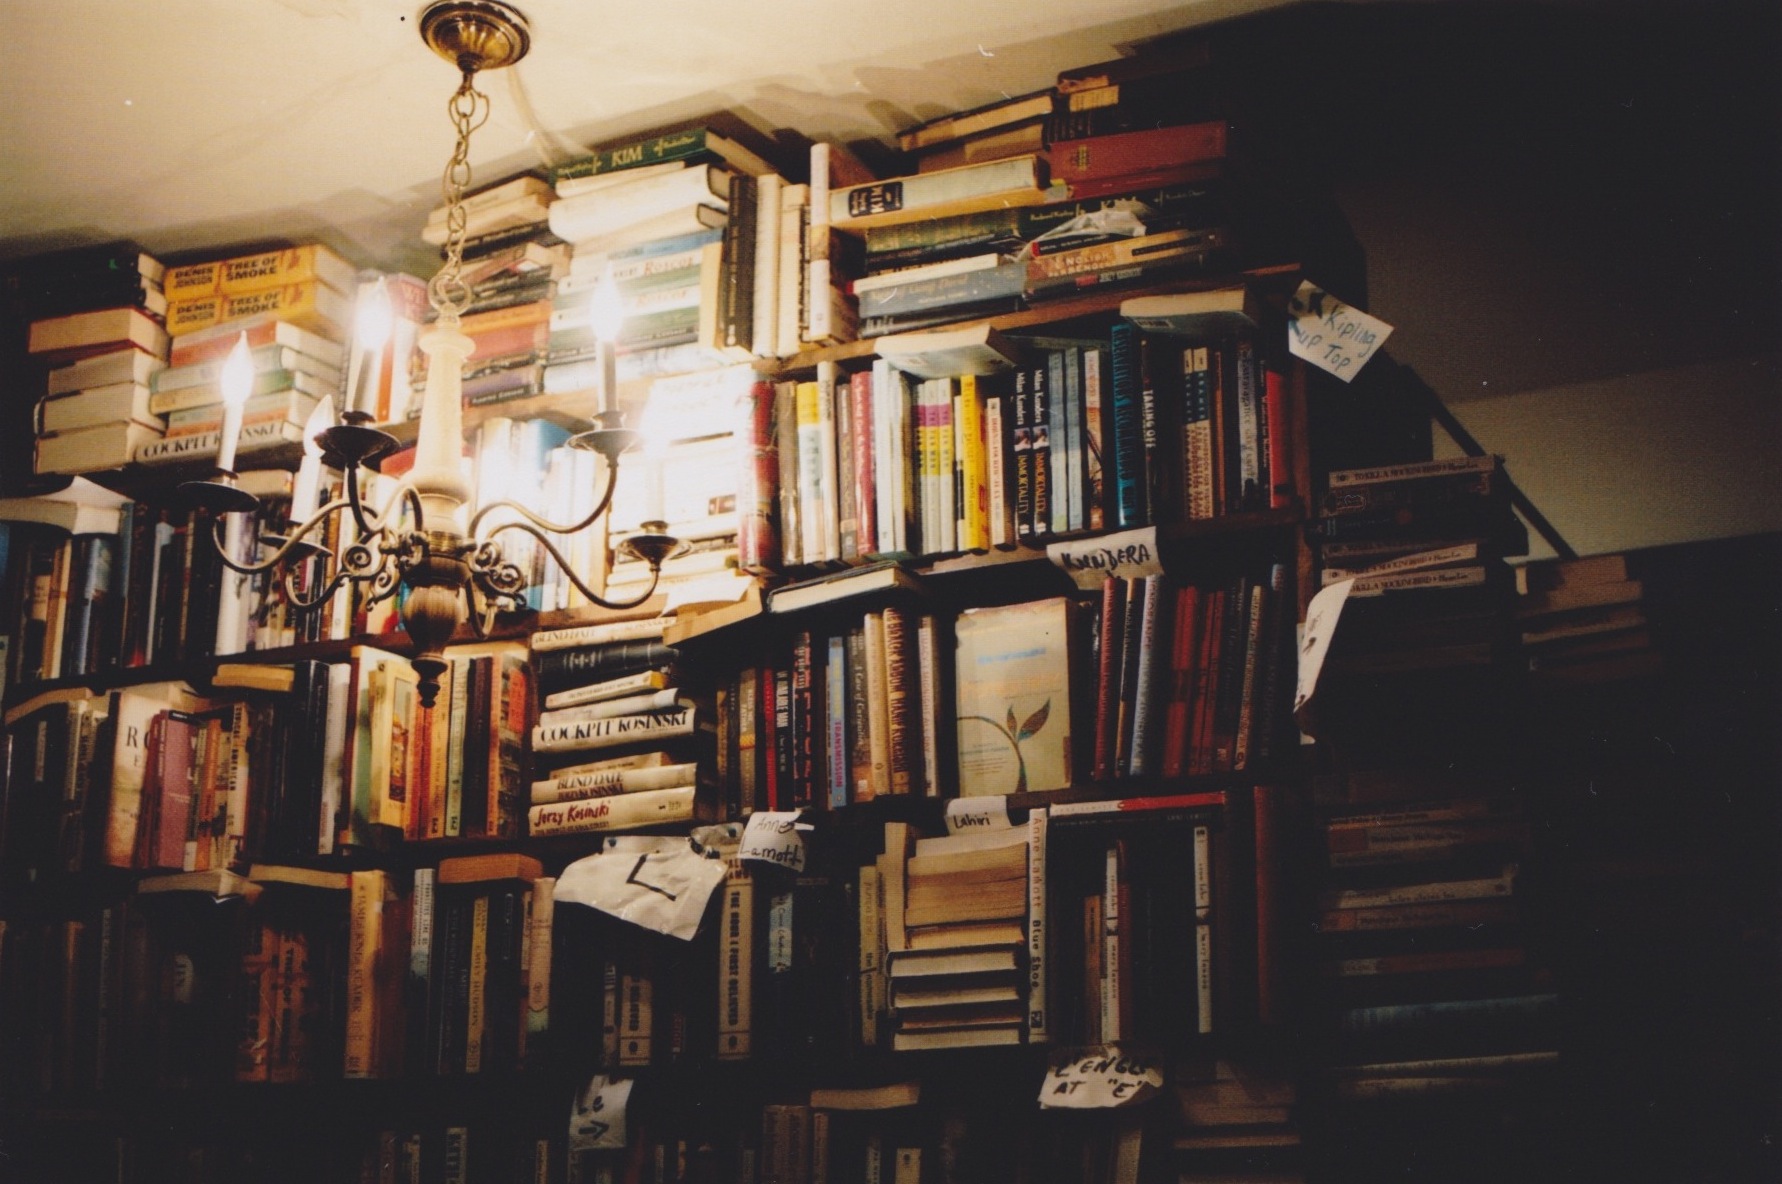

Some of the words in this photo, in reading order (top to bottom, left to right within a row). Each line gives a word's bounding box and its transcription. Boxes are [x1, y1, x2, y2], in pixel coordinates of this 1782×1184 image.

[612, 146, 643, 167] KIM
[225, 267, 277, 281] SMOKE
[228, 261, 259, 271] TREE
[1324, 303, 1376, 358] Kipling
[1016, 372, 1027, 394] Milan
[1034, 369, 1045, 392] Milan
[1016, 395, 1027, 426] Kundera
[1034, 392, 1046, 423] Kundera
[1143, 389, 1155, 427] TAKING
[1145, 429, 1157, 448] OFF
[1017, 455, 1029, 514] IMMORTALITY
[1035, 451, 1047, 512] IMMORTALITY
[541, 720, 612, 742] COCKPIT
[618, 711, 689, 733] KOSINSKI
[834, 720, 843, 788] TRANSMISSION
[534, 808, 564, 828] Jerzy
[567, 801, 612, 823] Kosinski
[954, 811, 991, 829] Lahiri
[1031, 817, 1042, 853] Anne
[730, 891, 741, 909] THE
[1031, 919, 1042, 951] Blue
[472, 944, 482, 977] EMILY
[729, 947, 739, 976] FIRST
[1031, 956, 1041, 988] Shoe
[470, 980, 480, 1027] HUDSON
[728, 978, 739, 1026] BELIEVED
[1053, 1080, 1087, 1095] AT
